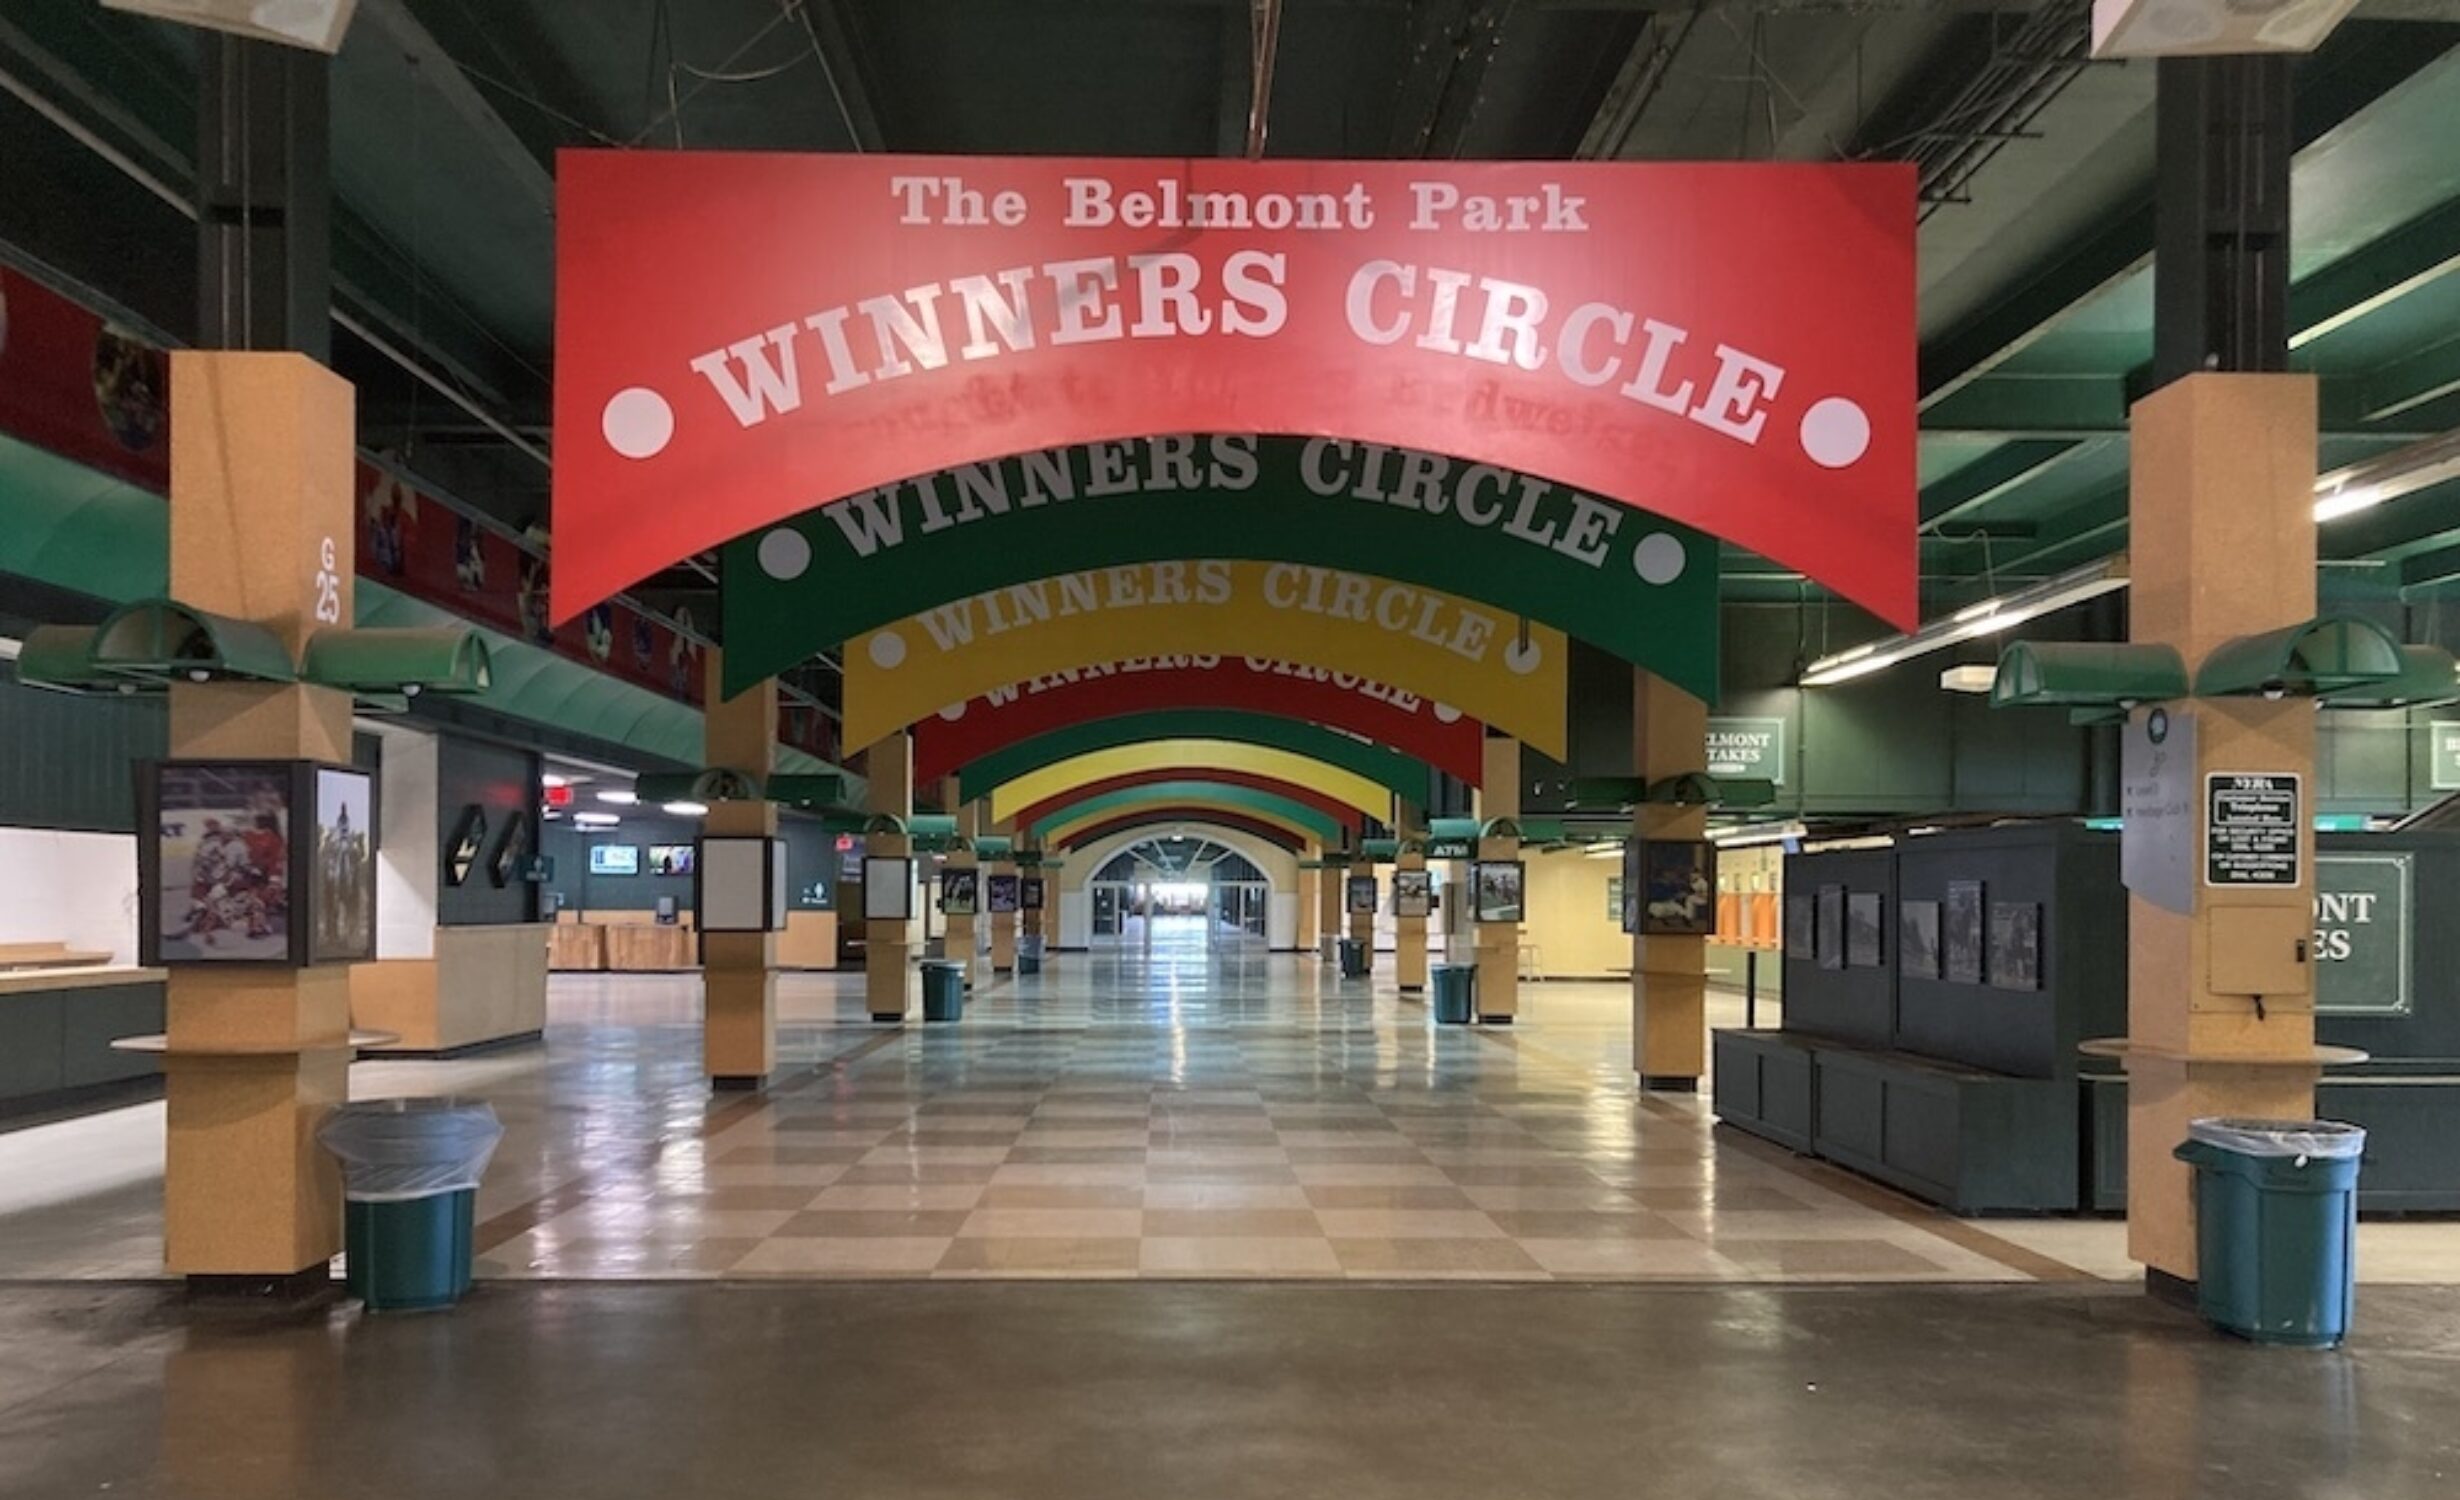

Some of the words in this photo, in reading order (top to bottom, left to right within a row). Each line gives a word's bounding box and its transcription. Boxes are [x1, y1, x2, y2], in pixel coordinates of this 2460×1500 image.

[891, 176, 1027, 226] The
[1063, 177, 1374, 230] Belmont
[1408, 181, 1589, 233] Park
[690, 250, 1288, 428] WINNERS
[1345, 260, 1786, 445] CIRCLE
[823, 434, 1259, 558] WINNERS
[1299, 436, 1624, 568] CIRCLE
[320, 536, 336, 571] G
[315, 570, 341, 625] 25
[916, 559, 1233, 652] WINNERS
[1263, 562, 1497, 663] CIRCLE
